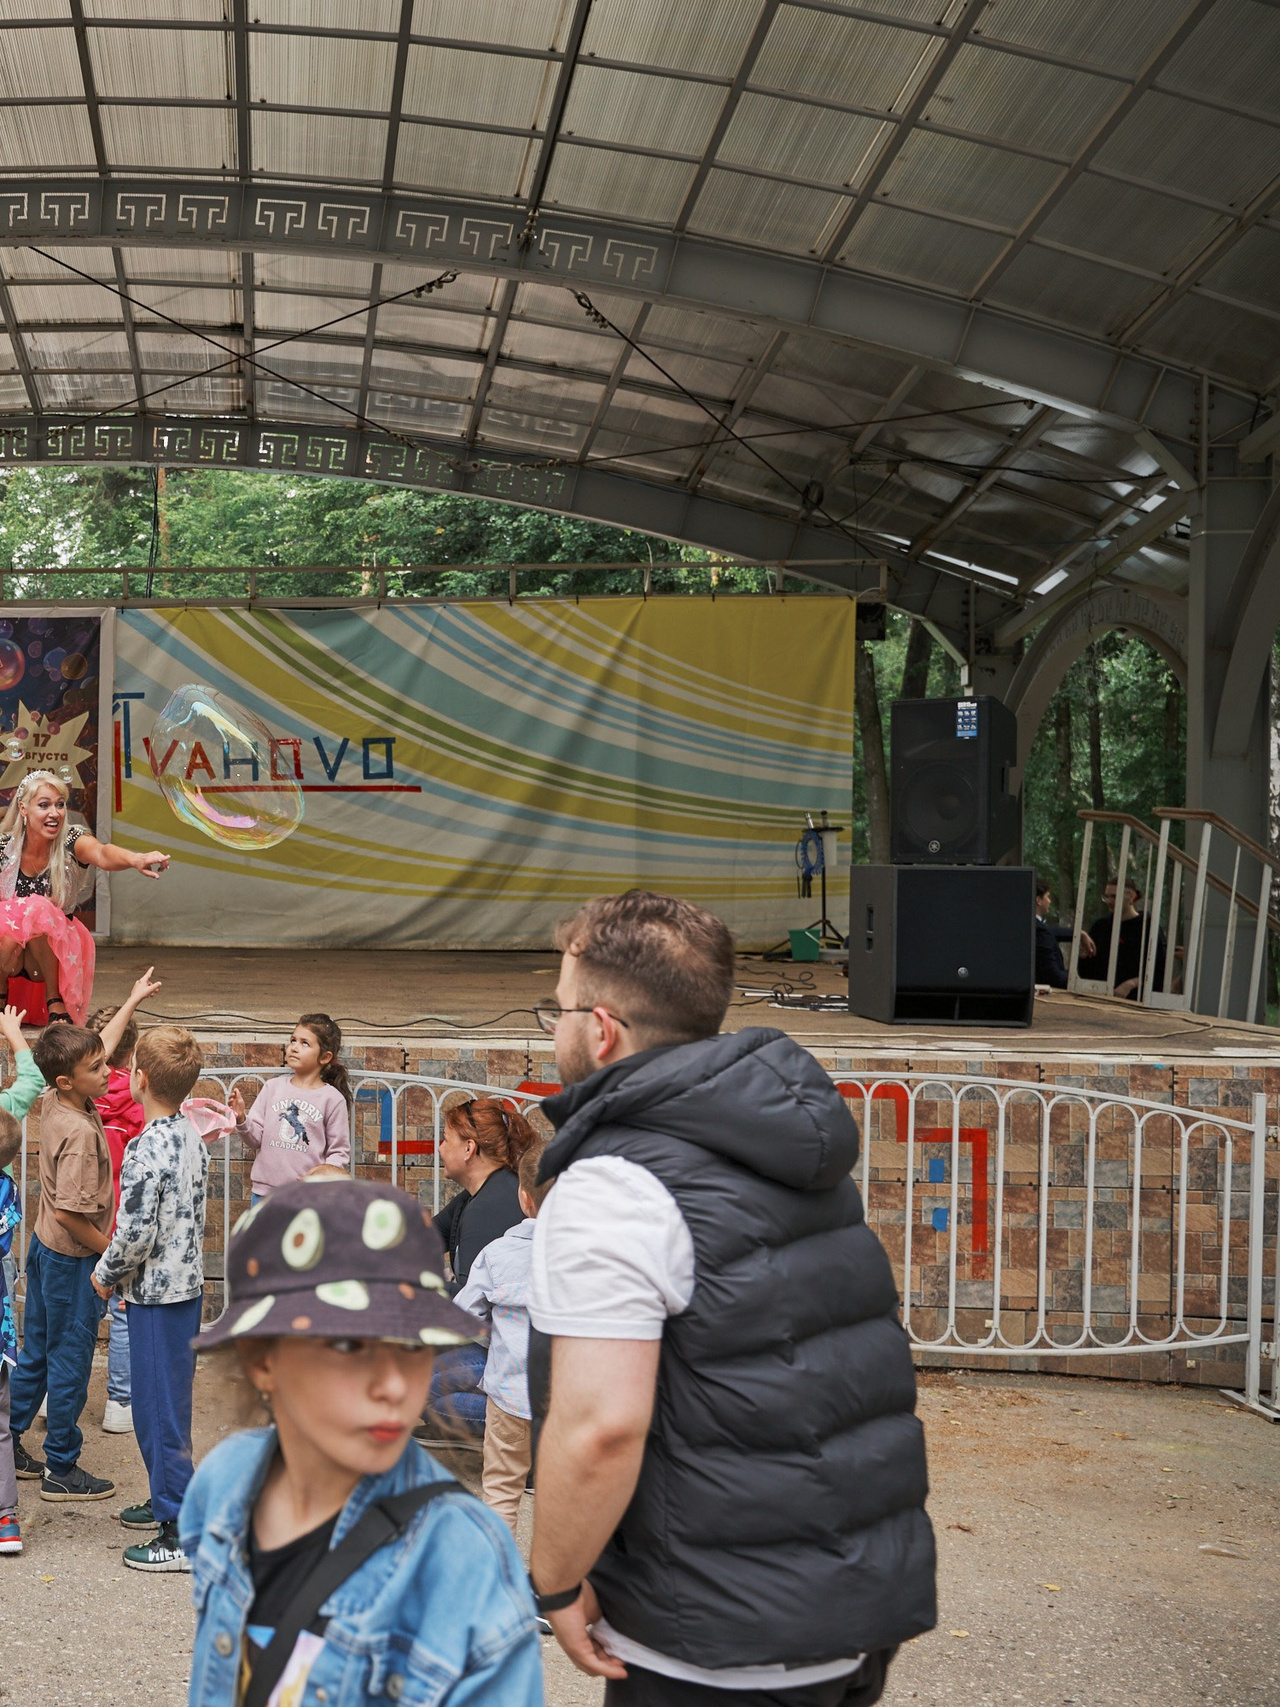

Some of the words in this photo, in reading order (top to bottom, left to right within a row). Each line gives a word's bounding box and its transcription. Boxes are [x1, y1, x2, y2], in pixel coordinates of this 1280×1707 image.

[32, 733, 52, 748] 17
[23, 751, 69, 763] вгуста
[270, 1140, 308, 1152] ACADEMY
